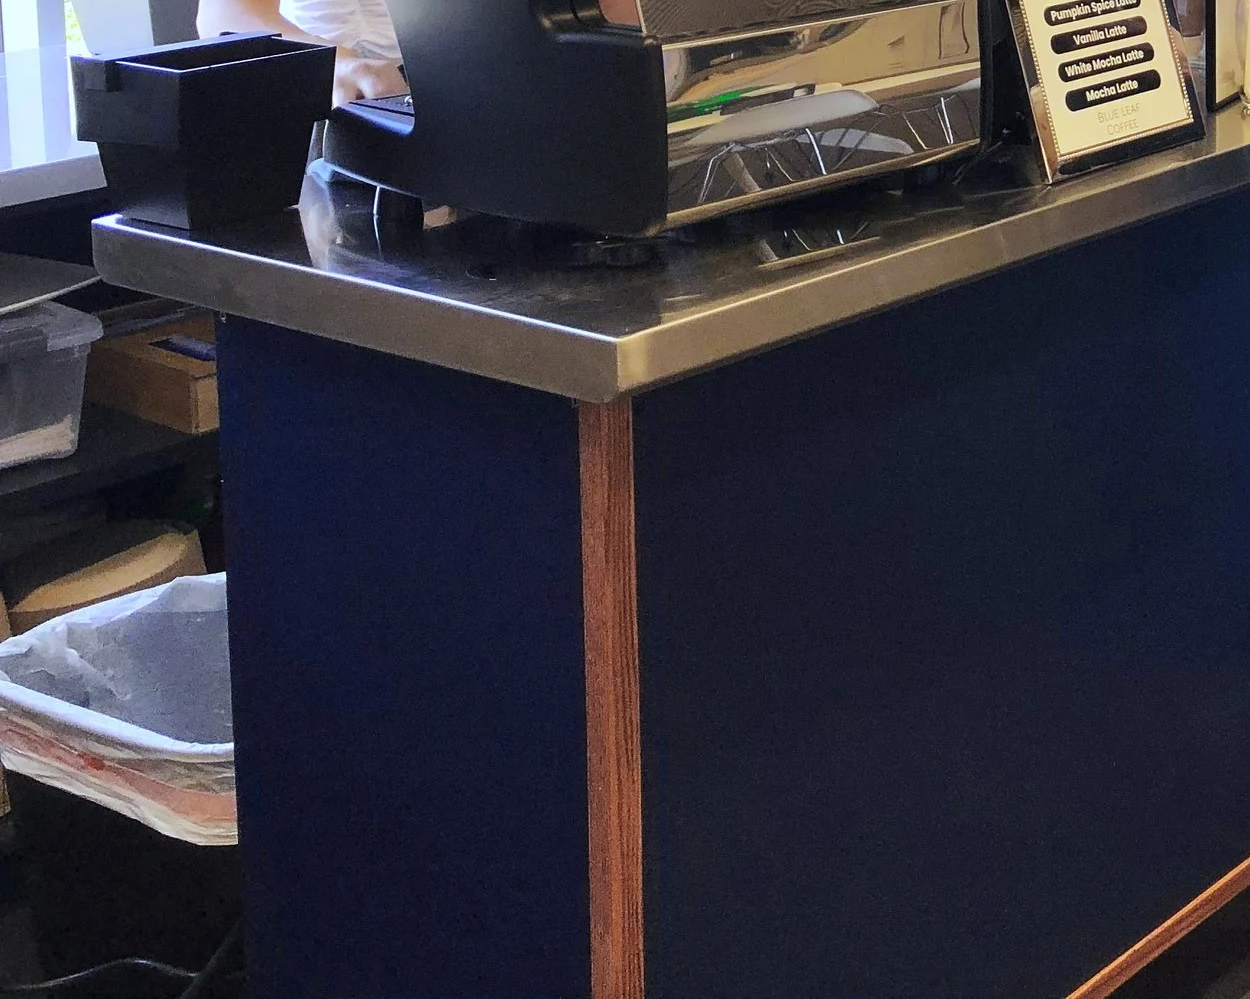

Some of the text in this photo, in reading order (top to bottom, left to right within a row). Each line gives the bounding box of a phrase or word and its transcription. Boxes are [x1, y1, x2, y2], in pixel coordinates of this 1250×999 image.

[1050, 3, 1091, 21] Pumpkin
[1090, 0, 1115, 14] Spice
[1073, 25, 1127, 46] Vanilla Latte
[1065, 49, 1145, 77] White Mocha Latte
[1085, 79, 1139, 102] Mocha Latte
[1097, 102, 1140, 123] BLUE LEAF
[1106, 118, 1139, 135] COFFEE
